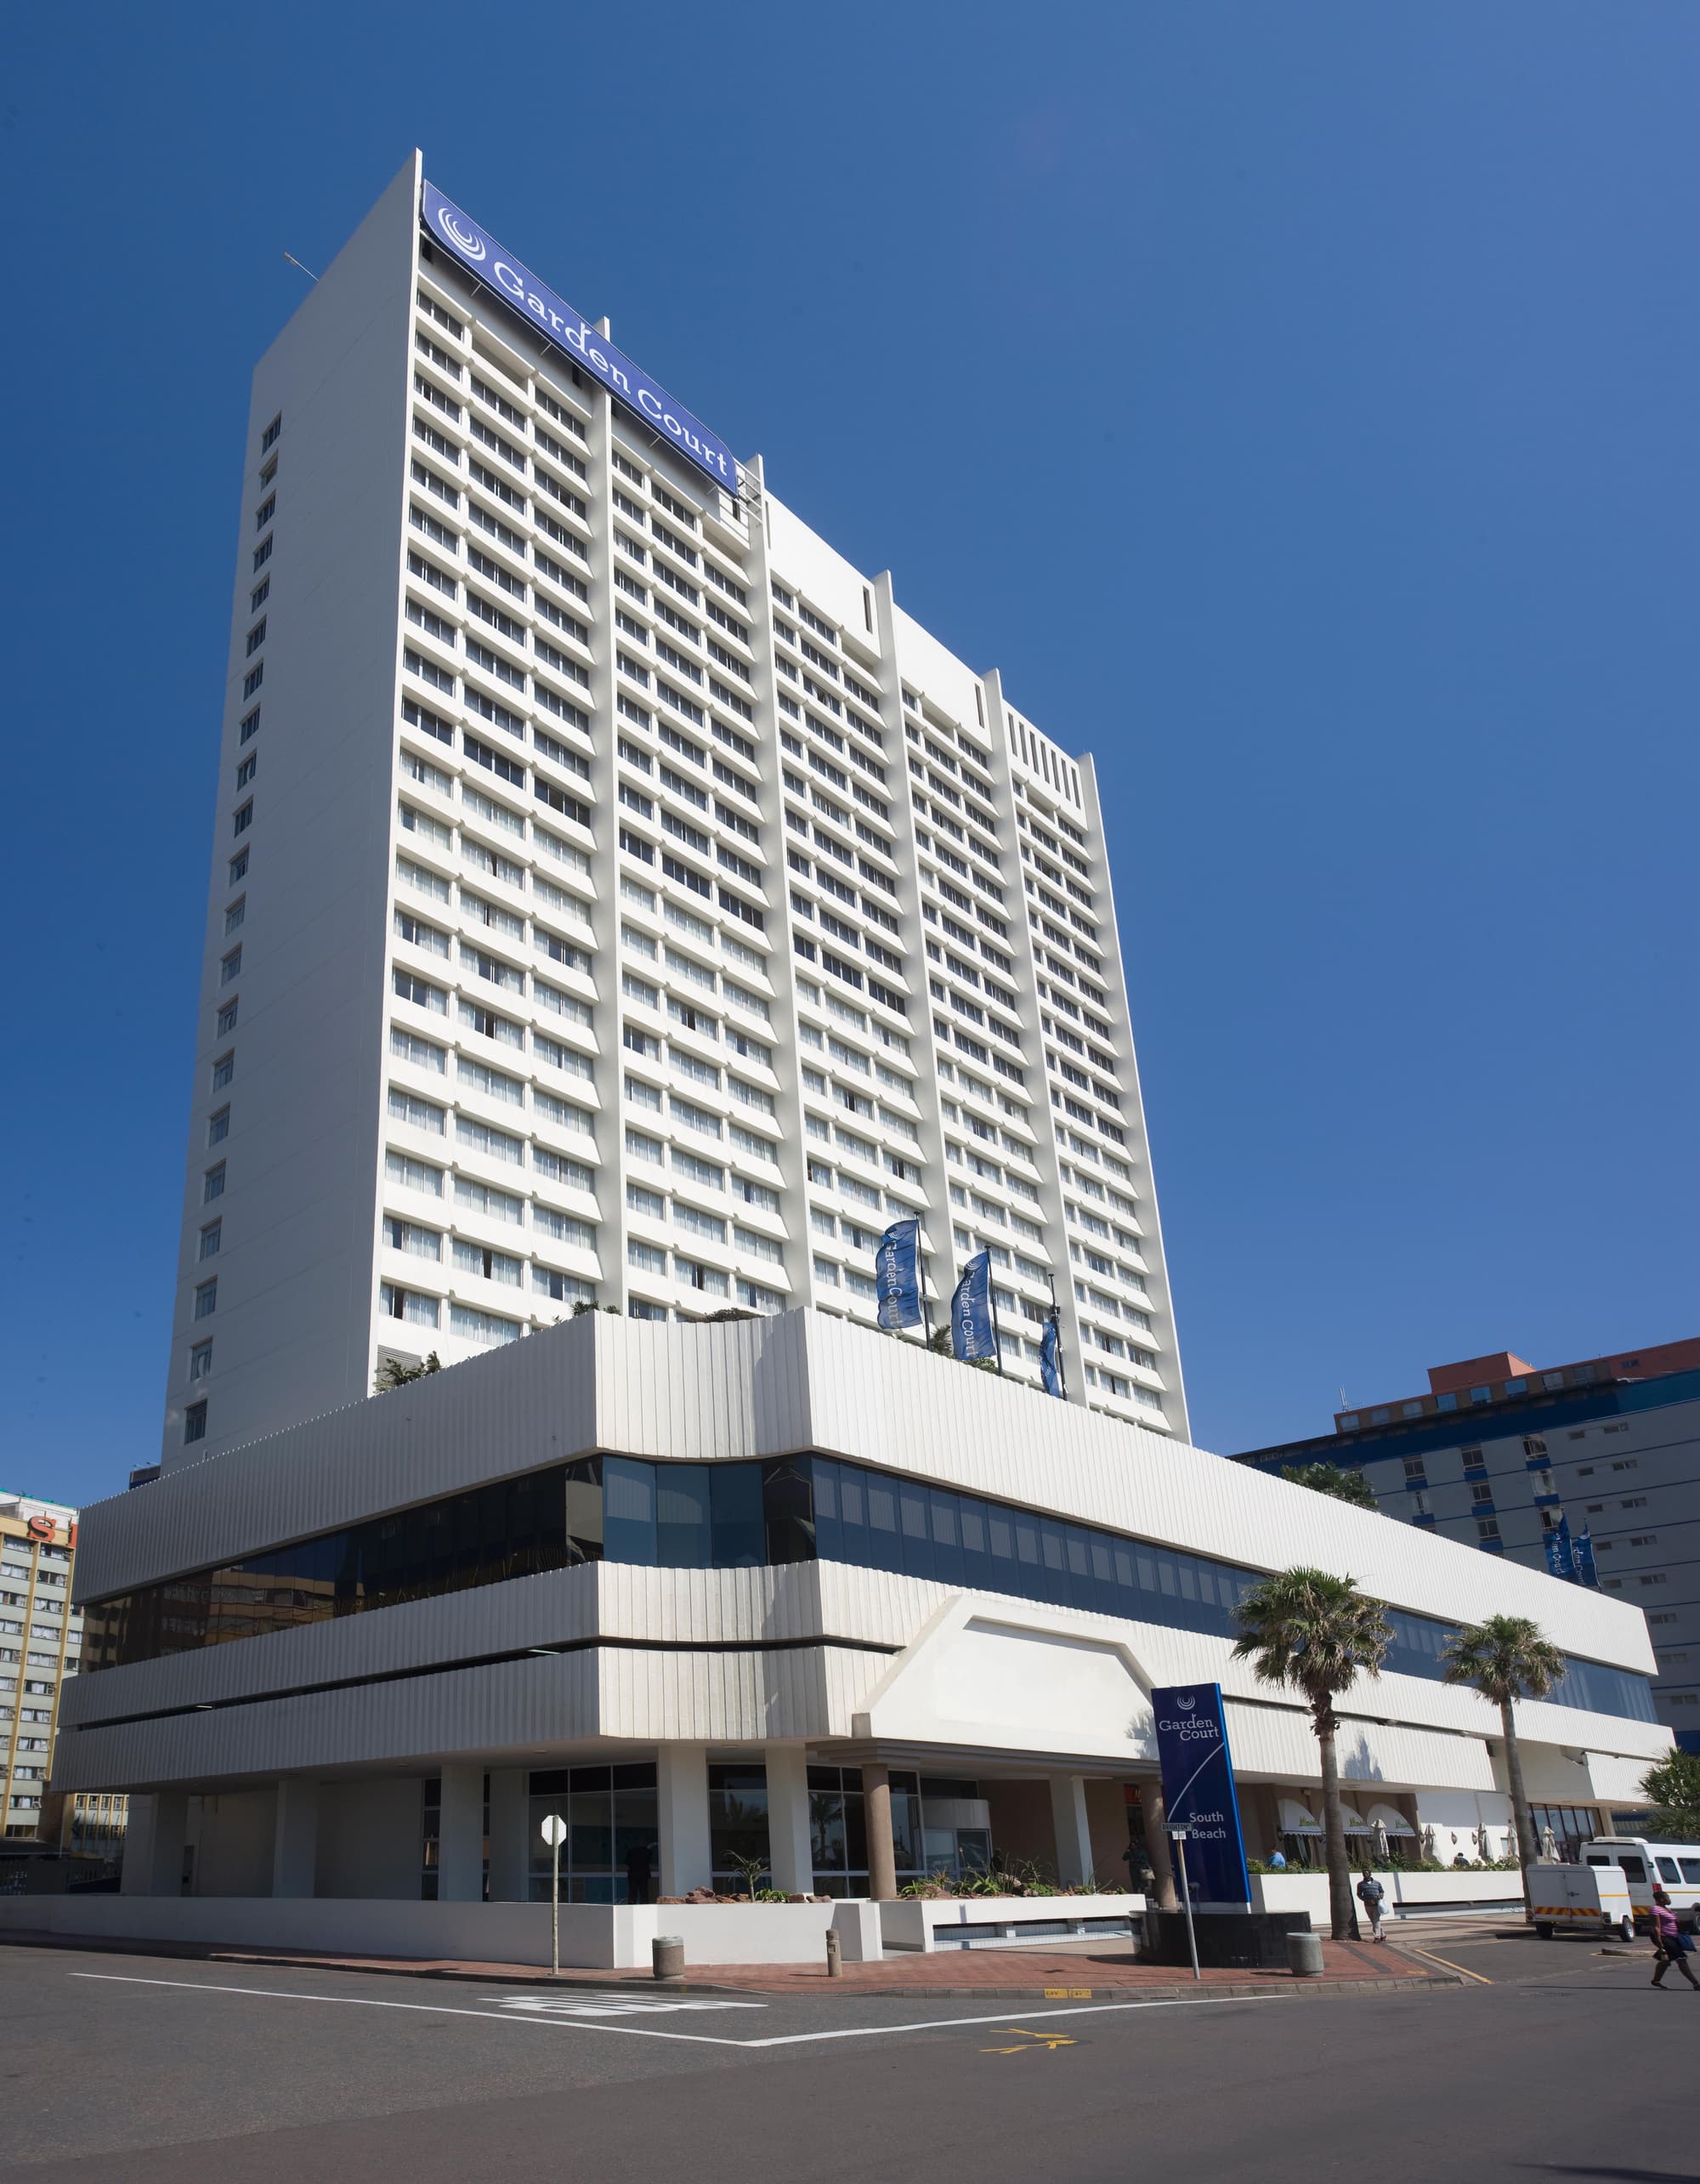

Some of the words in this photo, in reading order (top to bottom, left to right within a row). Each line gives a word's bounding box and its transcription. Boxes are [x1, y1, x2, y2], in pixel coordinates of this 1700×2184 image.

[494, 261, 631, 394] Garden
[638, 389, 728, 476] Court
[887, 1286, 904, 1326] Court
[961, 1319, 979, 1357] Court
[1159, 1713, 1214, 1732] Garden
[1179, 1727, 1220, 1741] Court
[1189, 1811, 1224, 1823] South
[1192, 1827, 1227, 1839] Beach
